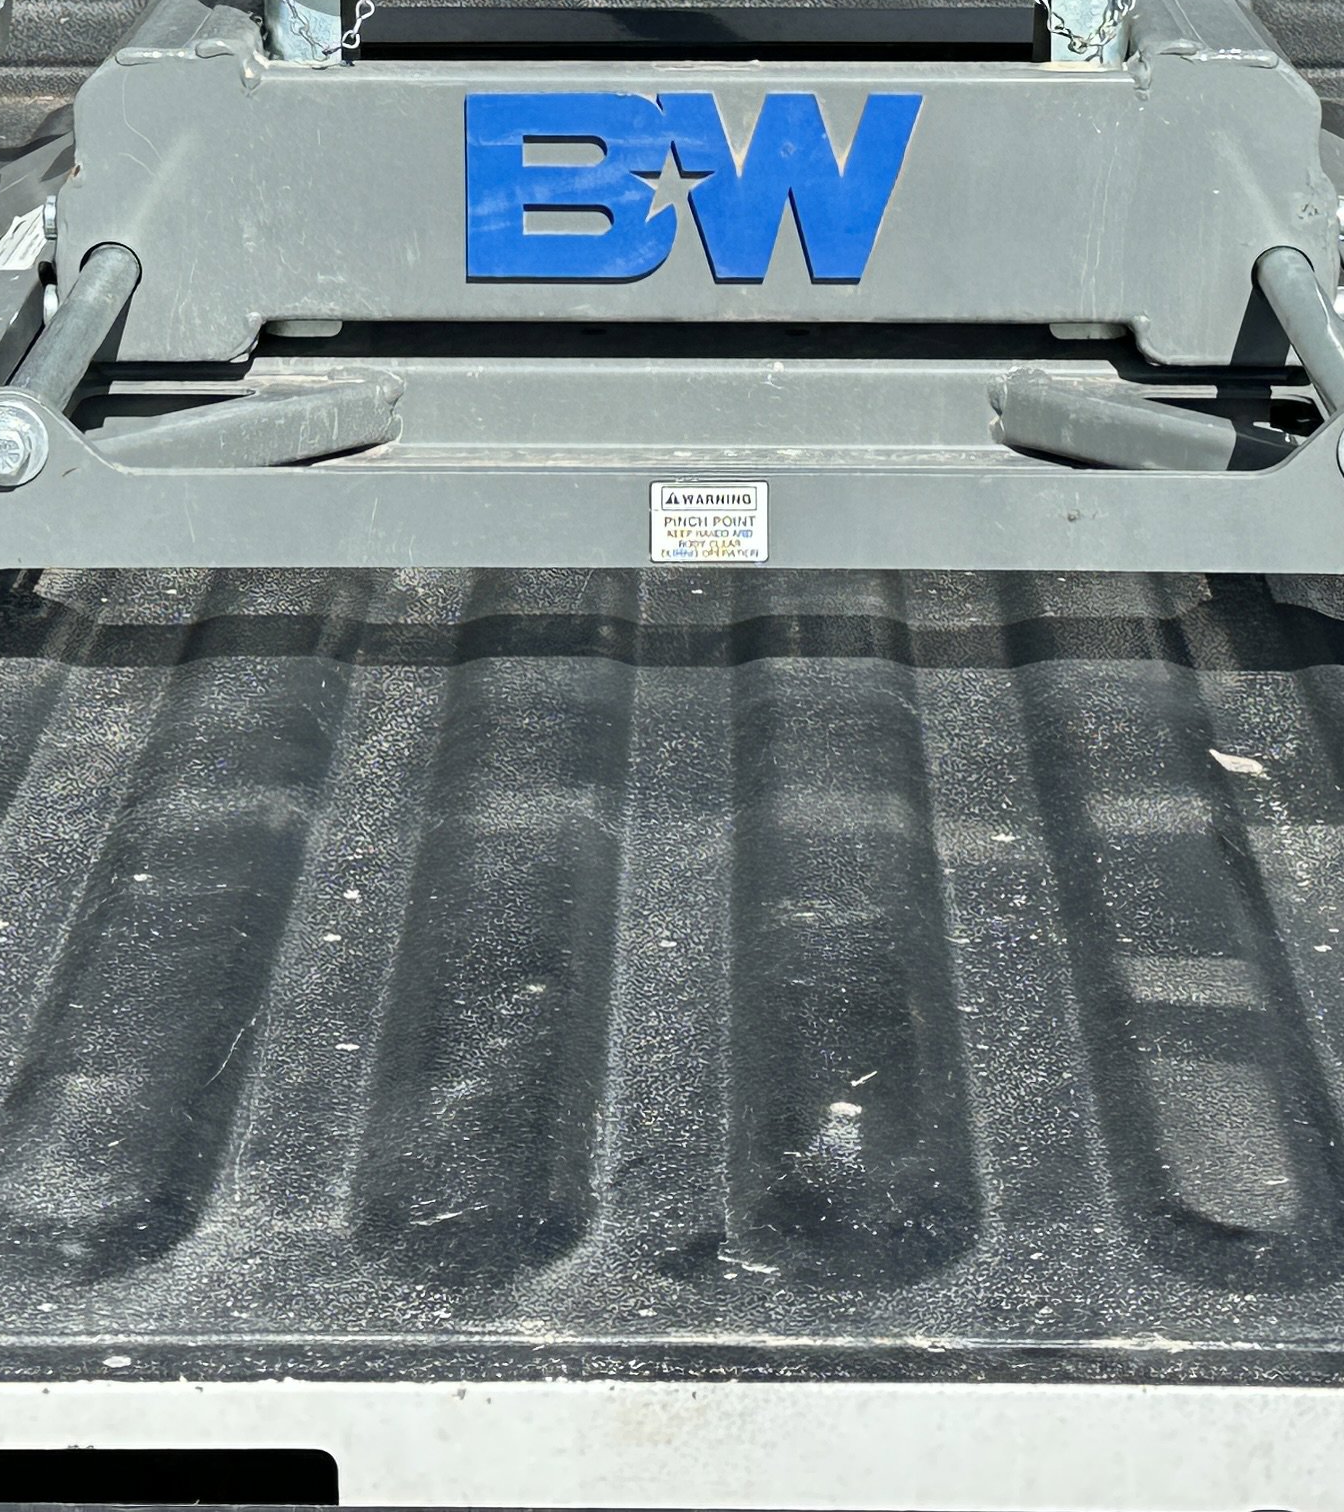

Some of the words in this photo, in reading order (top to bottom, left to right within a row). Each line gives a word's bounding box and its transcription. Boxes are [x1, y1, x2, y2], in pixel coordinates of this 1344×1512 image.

[682, 494, 752, 505] WARNING
[664, 516, 708, 527] PINCH
[712, 515, 756, 527] POINT
